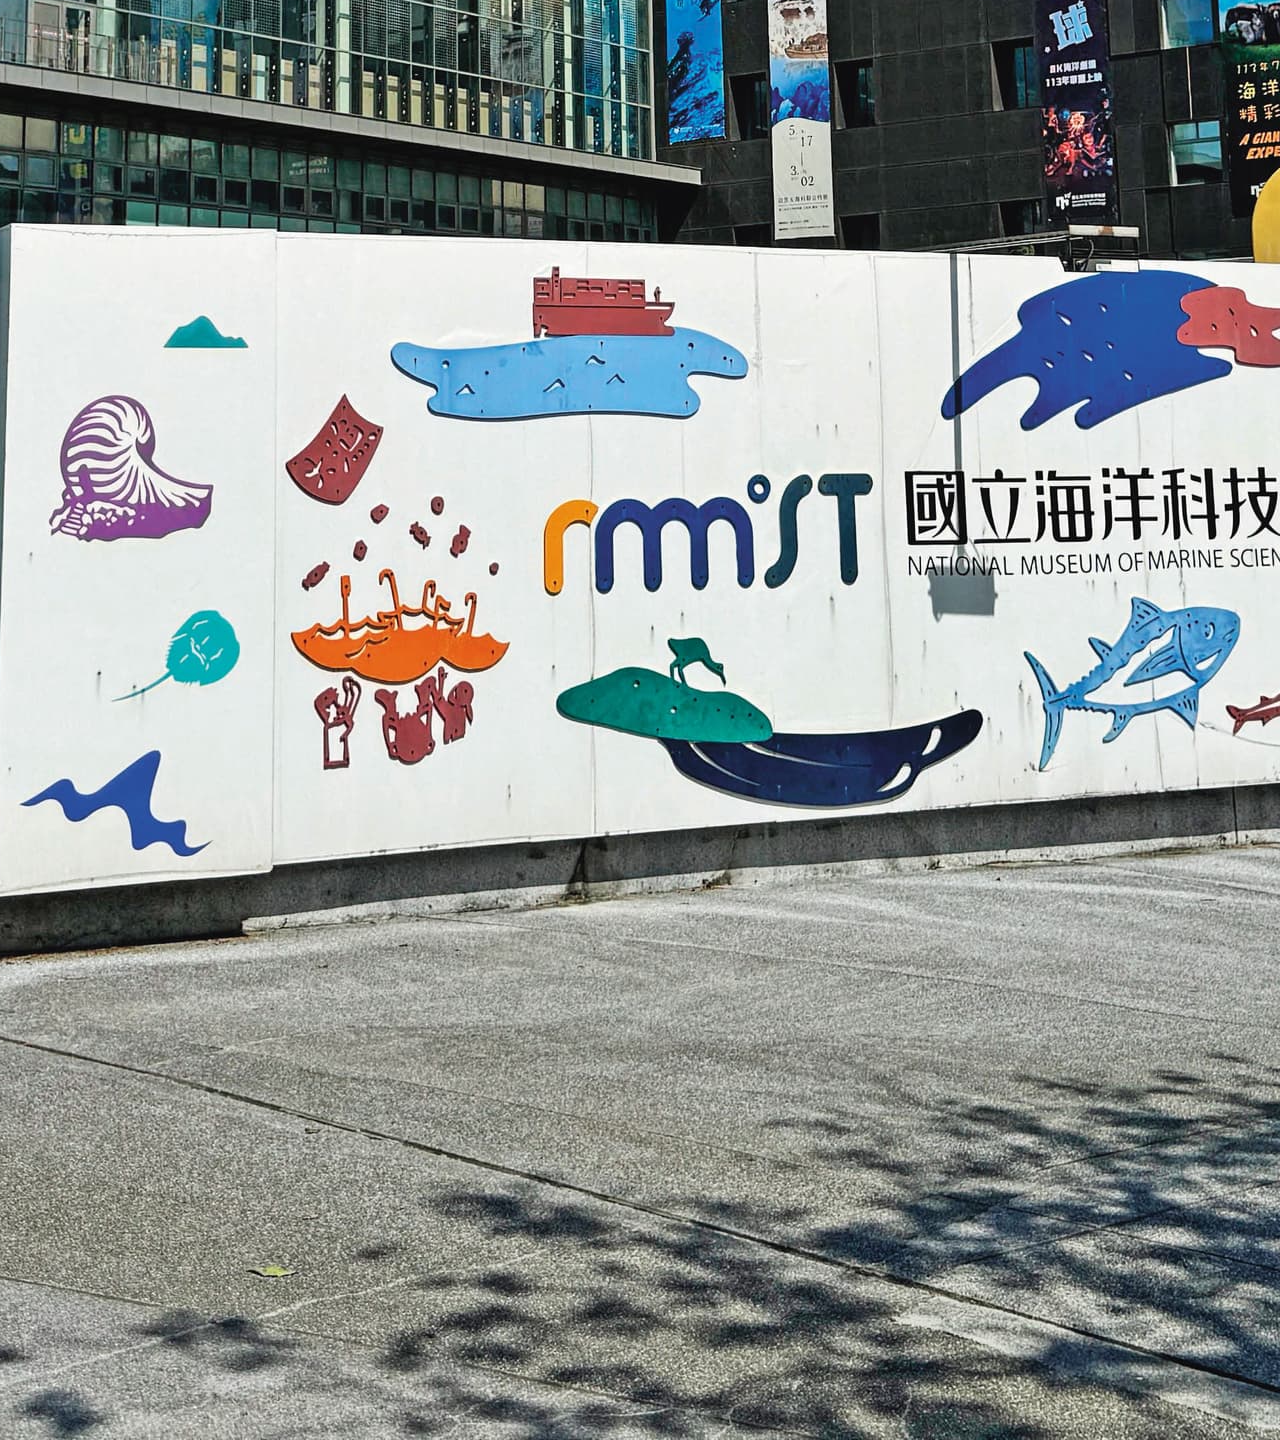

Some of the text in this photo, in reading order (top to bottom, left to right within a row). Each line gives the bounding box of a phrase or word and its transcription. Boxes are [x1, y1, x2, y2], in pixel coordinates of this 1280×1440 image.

[801, 135, 813, 148] 17
[1239, 133, 1251, 147] A
[800, 176, 815, 187] 02
[907, 555, 1015, 576] NATIONAL
[1020, 553, 1113, 575] MUSEUM
[1118, 552, 1144, 572] OF
[1148, 548, 1224, 570] MARINE
